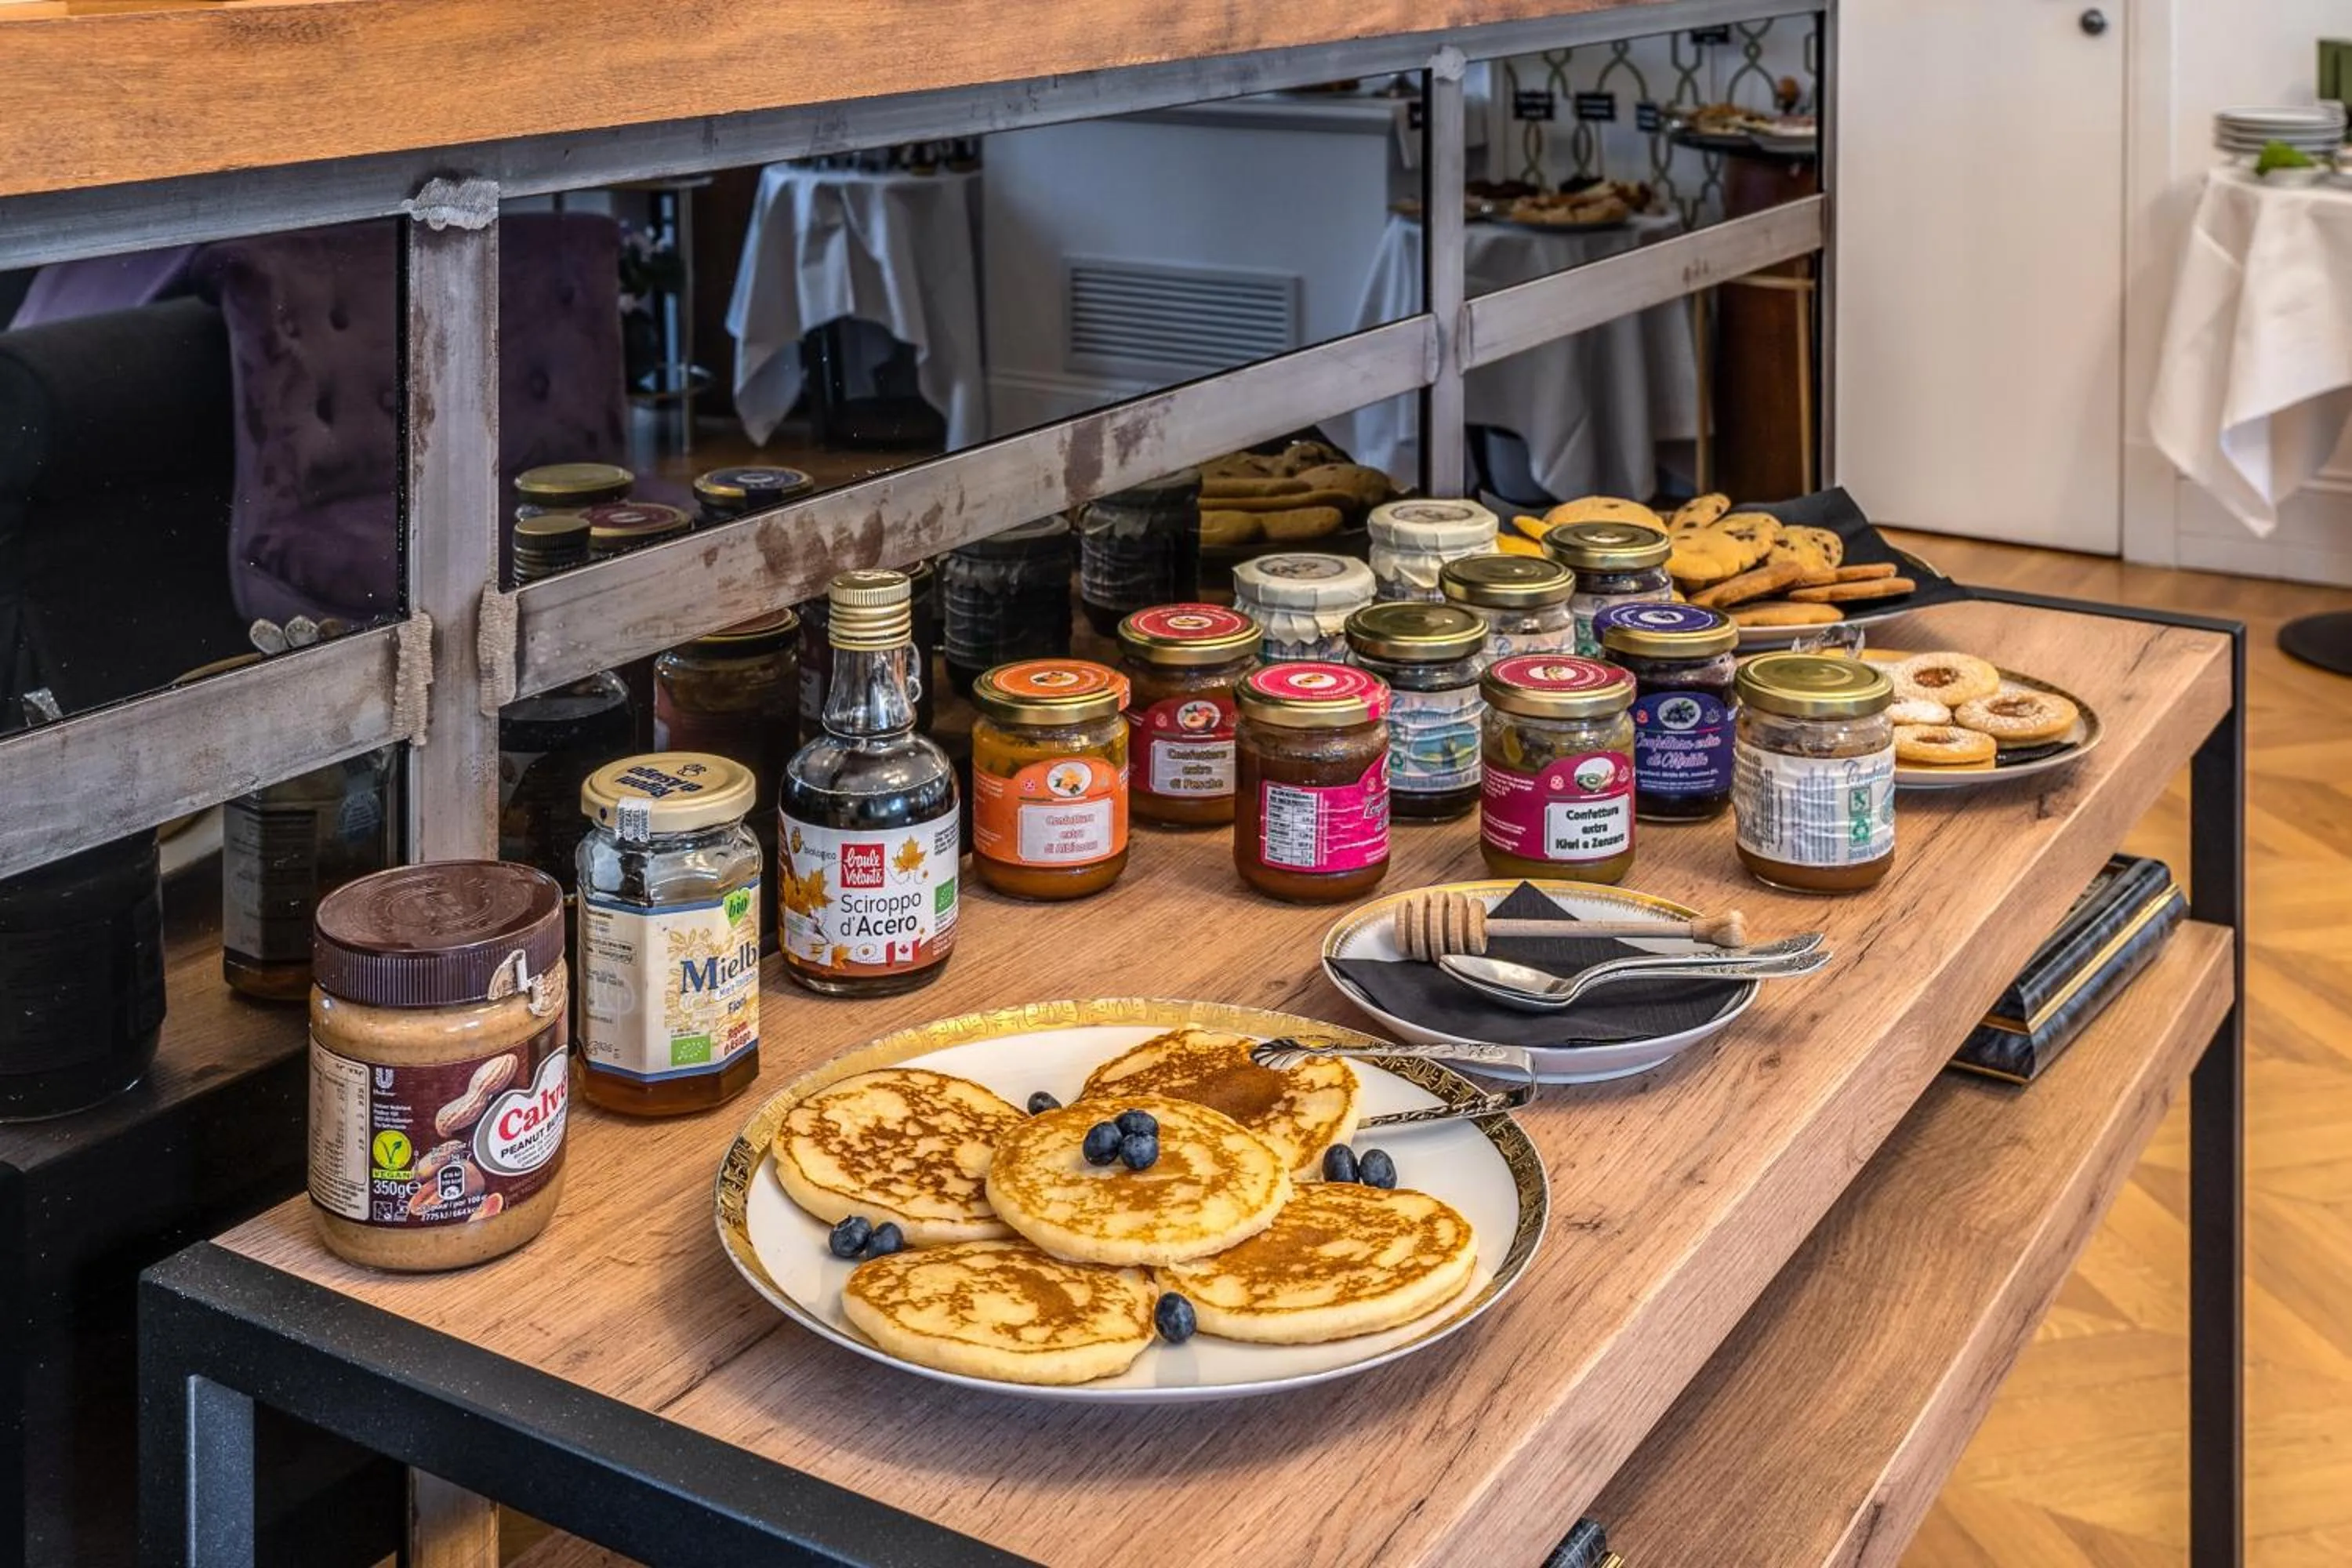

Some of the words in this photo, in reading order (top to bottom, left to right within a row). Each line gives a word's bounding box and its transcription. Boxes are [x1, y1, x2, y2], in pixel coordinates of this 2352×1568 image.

[840, 891, 922, 917] Sciroppo
[840, 914, 917, 938] d'Acero
[500, 1128, 545, 1159] PEANUT
